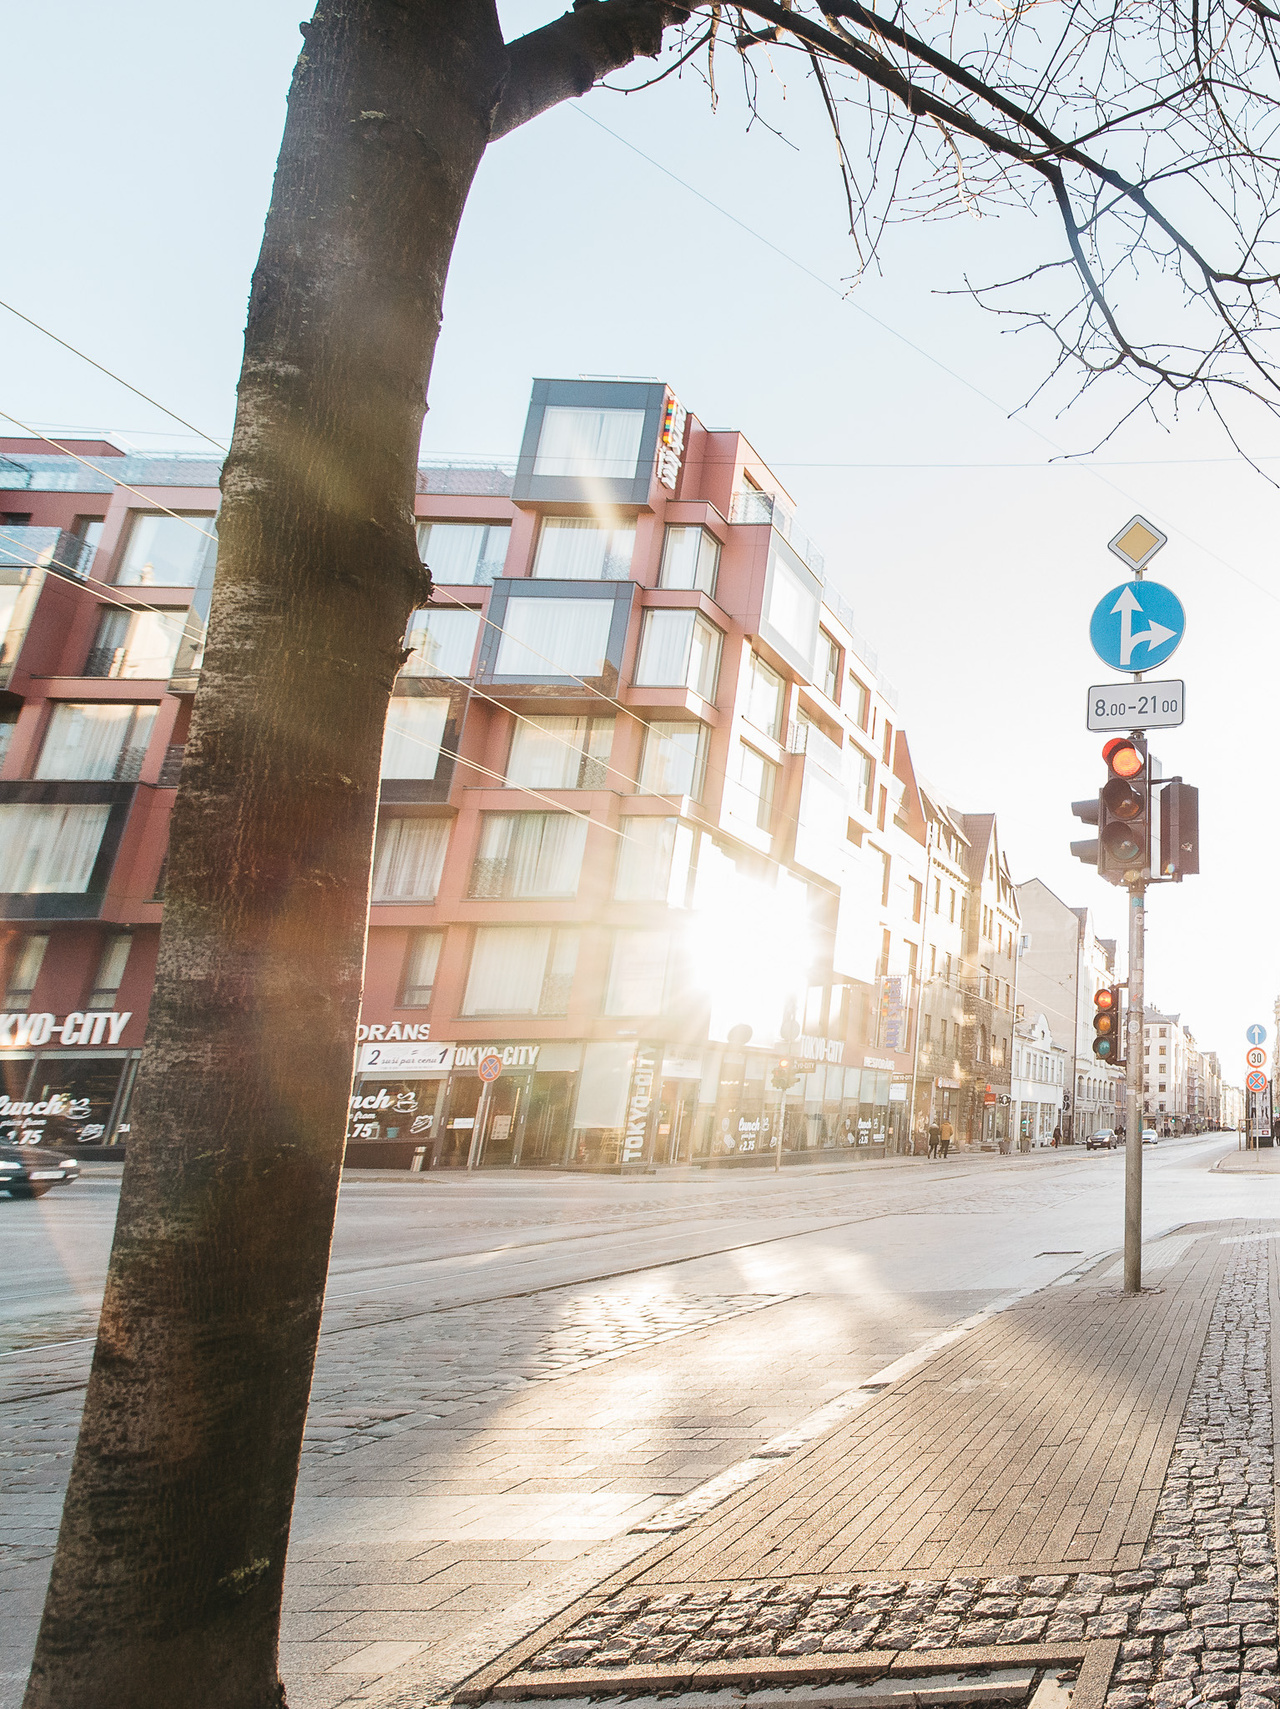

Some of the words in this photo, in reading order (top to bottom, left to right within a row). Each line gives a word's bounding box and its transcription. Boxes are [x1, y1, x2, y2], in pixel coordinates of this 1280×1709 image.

[368, 1049, 381, 1066] 2
[439, 1048, 449, 1064] 1
[800, 1034, 845, 1064] TOKYO-CITY
[1251, 1052, 1262, 1064] 30
